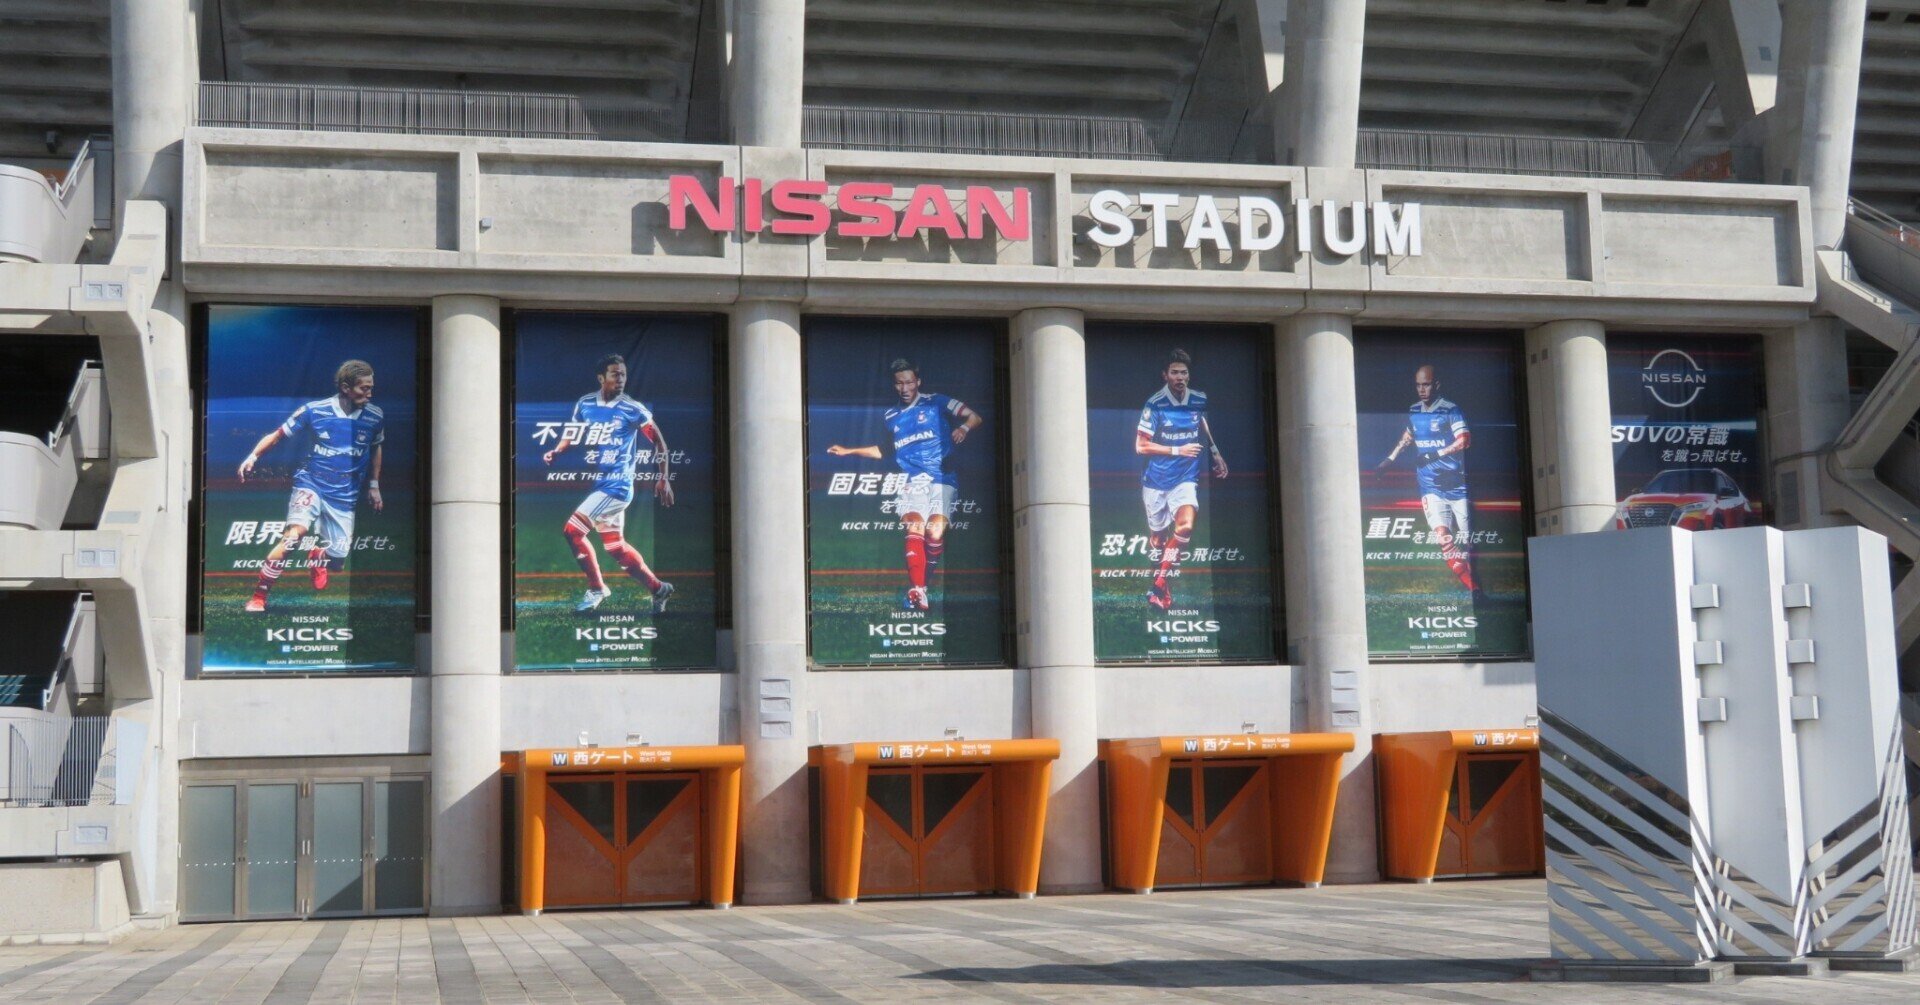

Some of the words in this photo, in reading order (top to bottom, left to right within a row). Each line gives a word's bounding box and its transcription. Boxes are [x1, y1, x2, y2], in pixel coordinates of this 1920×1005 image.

[669, 175, 1030, 241] NISSAN
[1087, 189, 1422, 257] STADIUM
[1642, 373, 1707, 384] NISSAN
[532, 421, 617, 446] 不可能
[894, 430, 935, 449] NISSAN
[1161, 430, 1199, 440] NISSAN
[1611, 424, 1730, 446] SUVの常識
[547, 472, 577, 481] KICK
[581, 472, 602, 481] THE
[605, 472, 678, 481] IMPOSSIBLE
[827, 472, 935, 496] 固定観念
[841, 521, 870, 530] KICK
[873, 521, 895, 530] THE
[1365, 551, 1391, 560] KICK
[1394, 551, 1414, 560] THE
[1416, 551, 1468, 560] PRESSURE
[233, 559, 265, 569] KICK
[269, 559, 292, 569] THE
[296, 559, 331, 568] LIMIT
[1100, 568, 1126, 578] KICK
[1130, 568, 1150, 578] THE
[1153, 568, 1181, 578] FEAR
[599, 615, 635, 623] NISSAN
[891, 611, 925, 619] NISSAN
[1146, 620, 1220, 633] KICKS
[1408, 616, 1478, 629] KICKS
[267, 627, 354, 641] KICKS
[576, 627, 658, 640] KICKS
[869, 623, 947, 636] KICKS
[1185, 740, 1197, 751] W
[1203, 737, 1257, 751] 西ゲート
[1475, 734, 1487, 745] W
[880, 746, 893, 758] W
[899, 743, 956, 758] 西ゲート
[553, 753, 567, 765] W
[573, 750, 633, 765] 西ゲート
